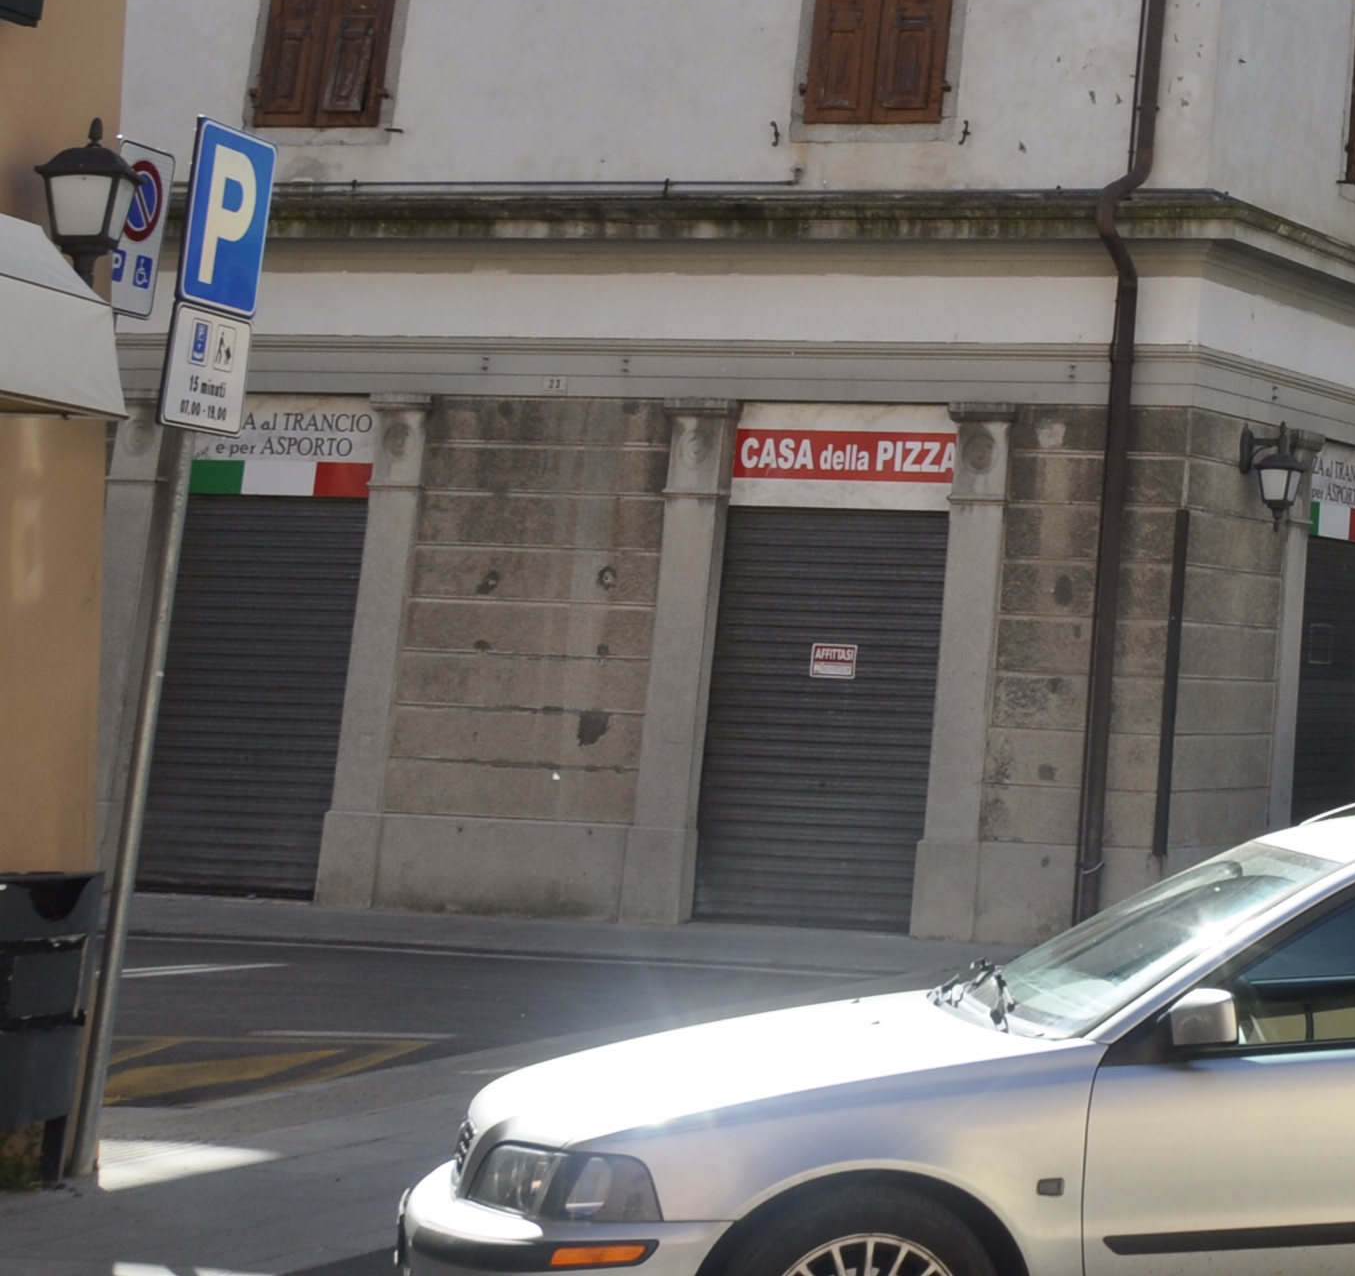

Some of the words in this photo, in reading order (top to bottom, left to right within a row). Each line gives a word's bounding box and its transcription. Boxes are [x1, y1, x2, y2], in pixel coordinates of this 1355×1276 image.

[198, 144, 257, 285] P
[189, 375, 200, 393] 15
[201, 379, 226, 399] minuti
[261, 413, 278, 431] al
[283, 413, 373, 433] TRANCIO
[216, 442, 225, 455] e
[229, 443, 256, 458] per
[261, 436, 353, 457] ASPORTO
[741, 437, 814, 470] CASA
[819, 443, 870, 472] della
[876, 440, 957, 473] PIZZA
[814, 647, 855, 661] AFFITTASI
